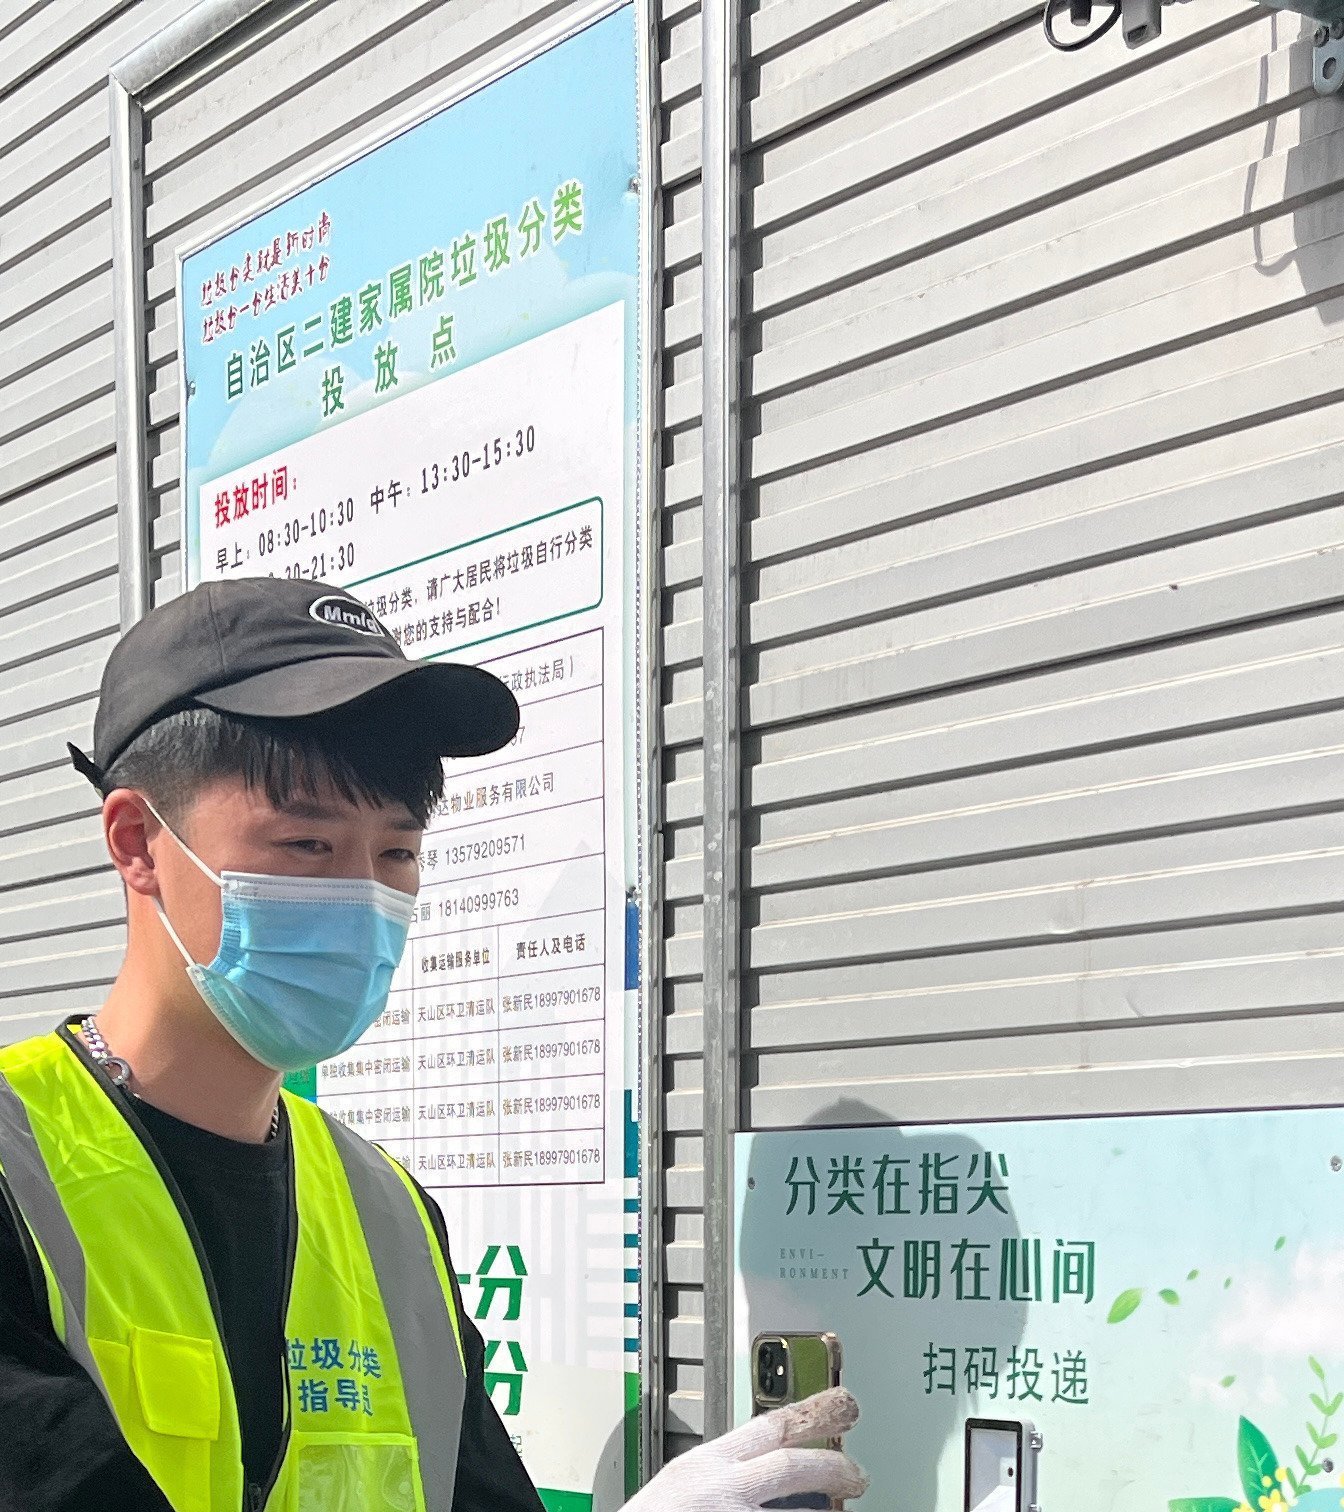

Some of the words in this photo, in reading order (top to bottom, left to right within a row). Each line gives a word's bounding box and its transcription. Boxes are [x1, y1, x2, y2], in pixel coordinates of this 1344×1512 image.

[227, 180, 583, 400] 自治区二建家属院垃圾分类
[445, 833, 525, 866] 13579209571
[438, 887, 519, 918] 18140999763
[418, 998, 496, 1022] 天山区环卫清运队
[418, 1048, 496, 1071] 天山区环卫清运队
[418, 1100, 496, 1120] 天山区环卫清运队
[418, 1151, 496, 1171] 天山区环卫清运队
[784, 1151, 1009, 1215] 分类在指尖
[457, 1245, 528, 1321] 分
[856, 1237, 1096, 1305] 文明在心间
[286, 1337, 382, 1379] 垃圾分类
[922, 1342, 1089, 1404] 扫码投递
